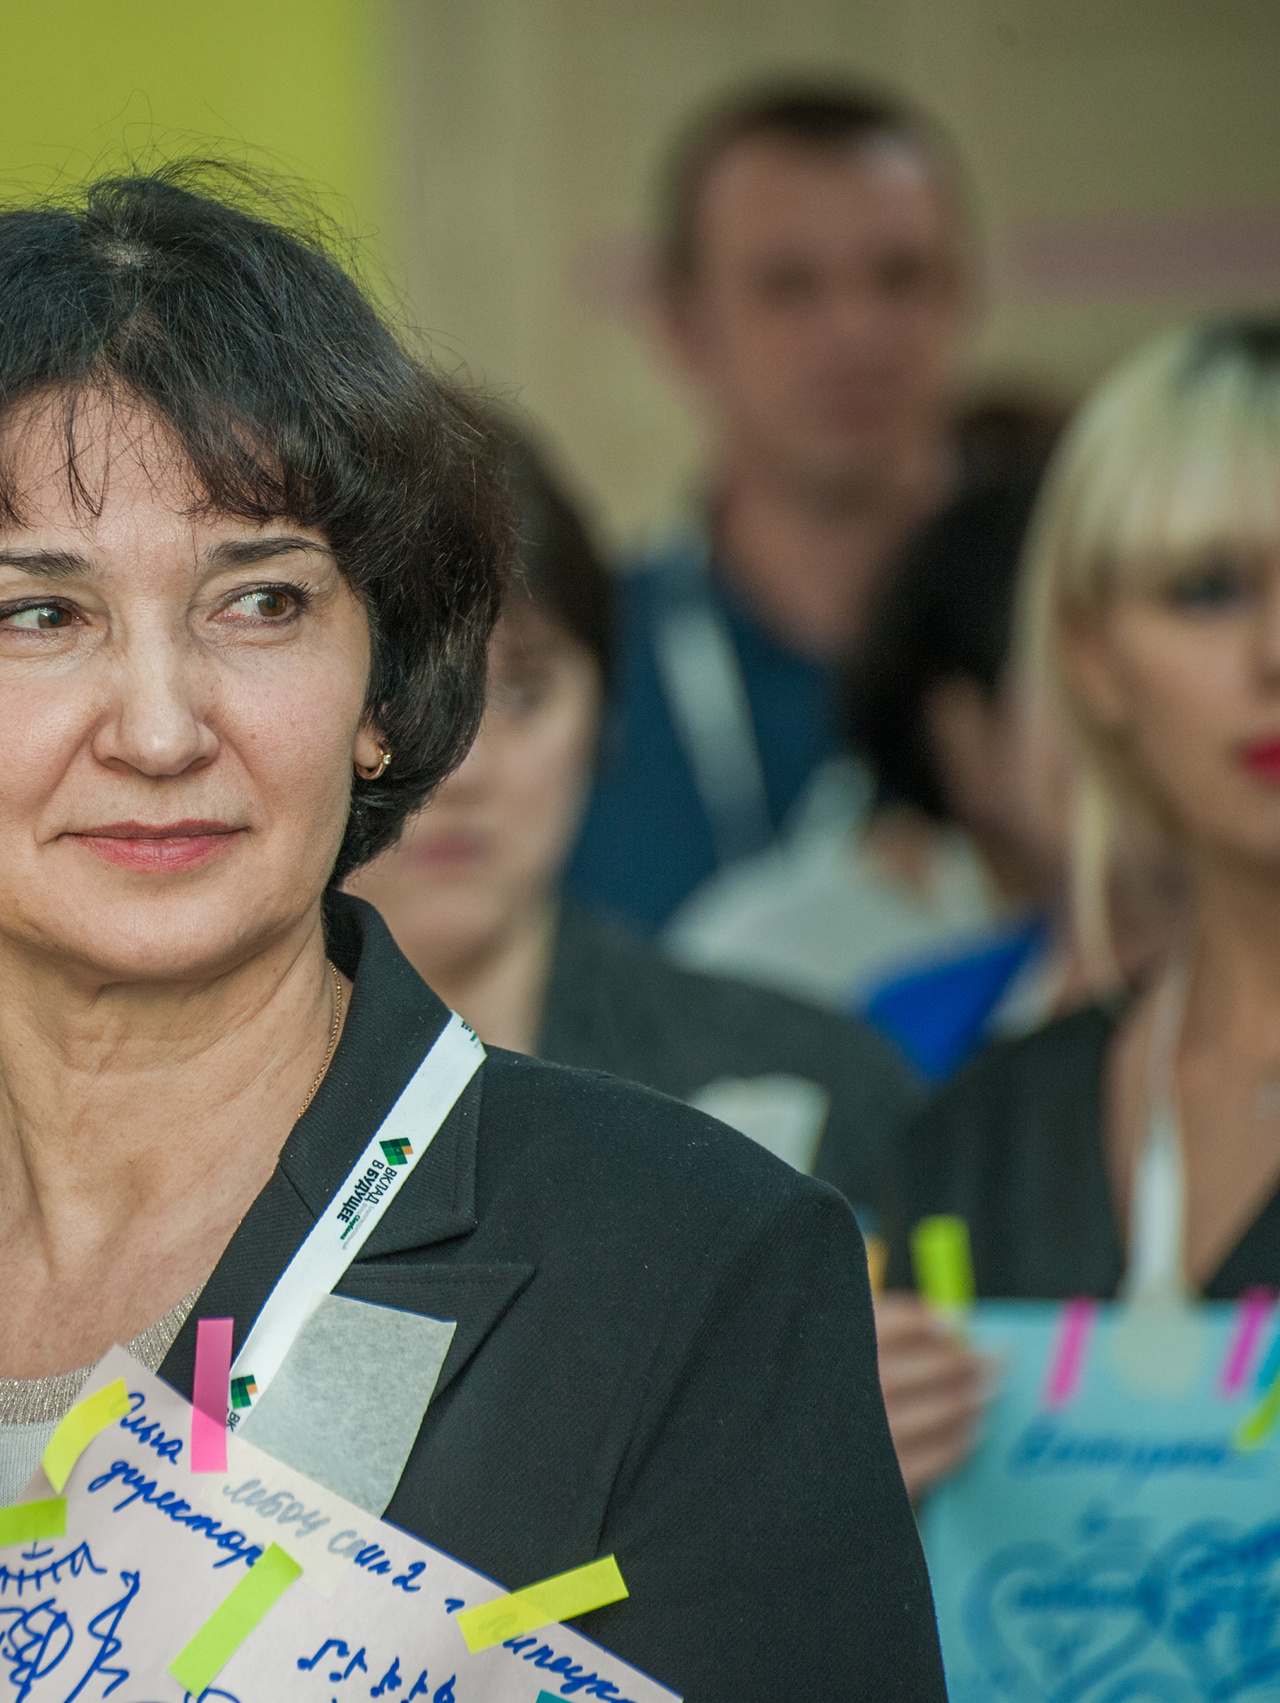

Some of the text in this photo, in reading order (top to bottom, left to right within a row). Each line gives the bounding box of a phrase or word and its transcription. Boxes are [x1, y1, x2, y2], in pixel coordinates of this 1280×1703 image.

[336, 1159, 385, 1223] В БУДУЩЕЕ
[363, 1166, 398, 1205] ВКЛАД
[86, 1459, 266, 1570] директор
